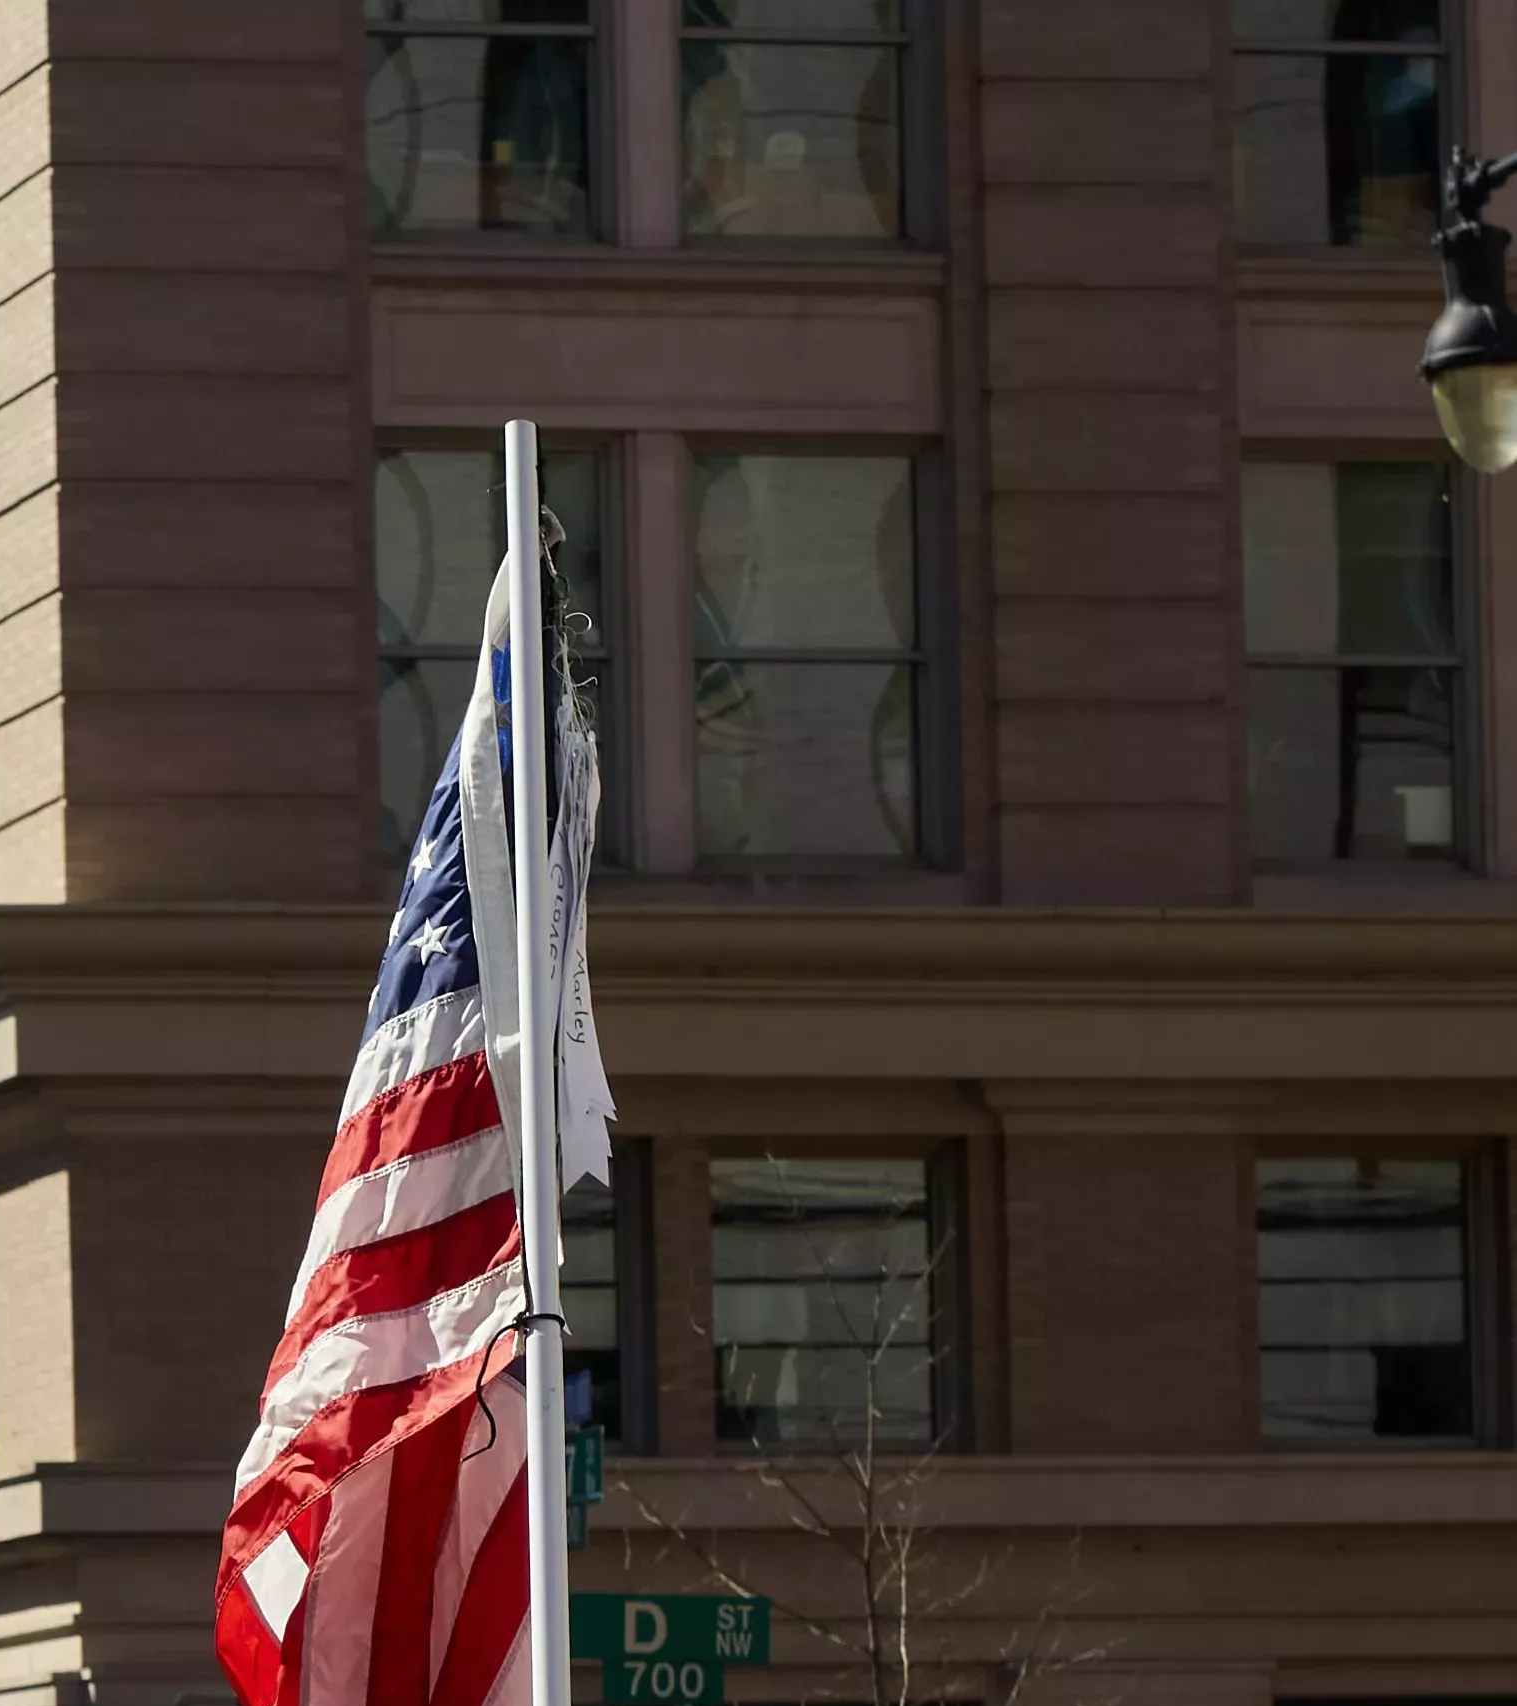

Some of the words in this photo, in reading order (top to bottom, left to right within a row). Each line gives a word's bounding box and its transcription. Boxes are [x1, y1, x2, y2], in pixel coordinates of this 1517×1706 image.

[565, 949, 589, 1045] Marley
[624, 1601, 668, 1654] D
[716, 1604, 754, 1629] ST
[715, 1631, 753, 1657] NW
[624, 1661, 705, 1699] 700
